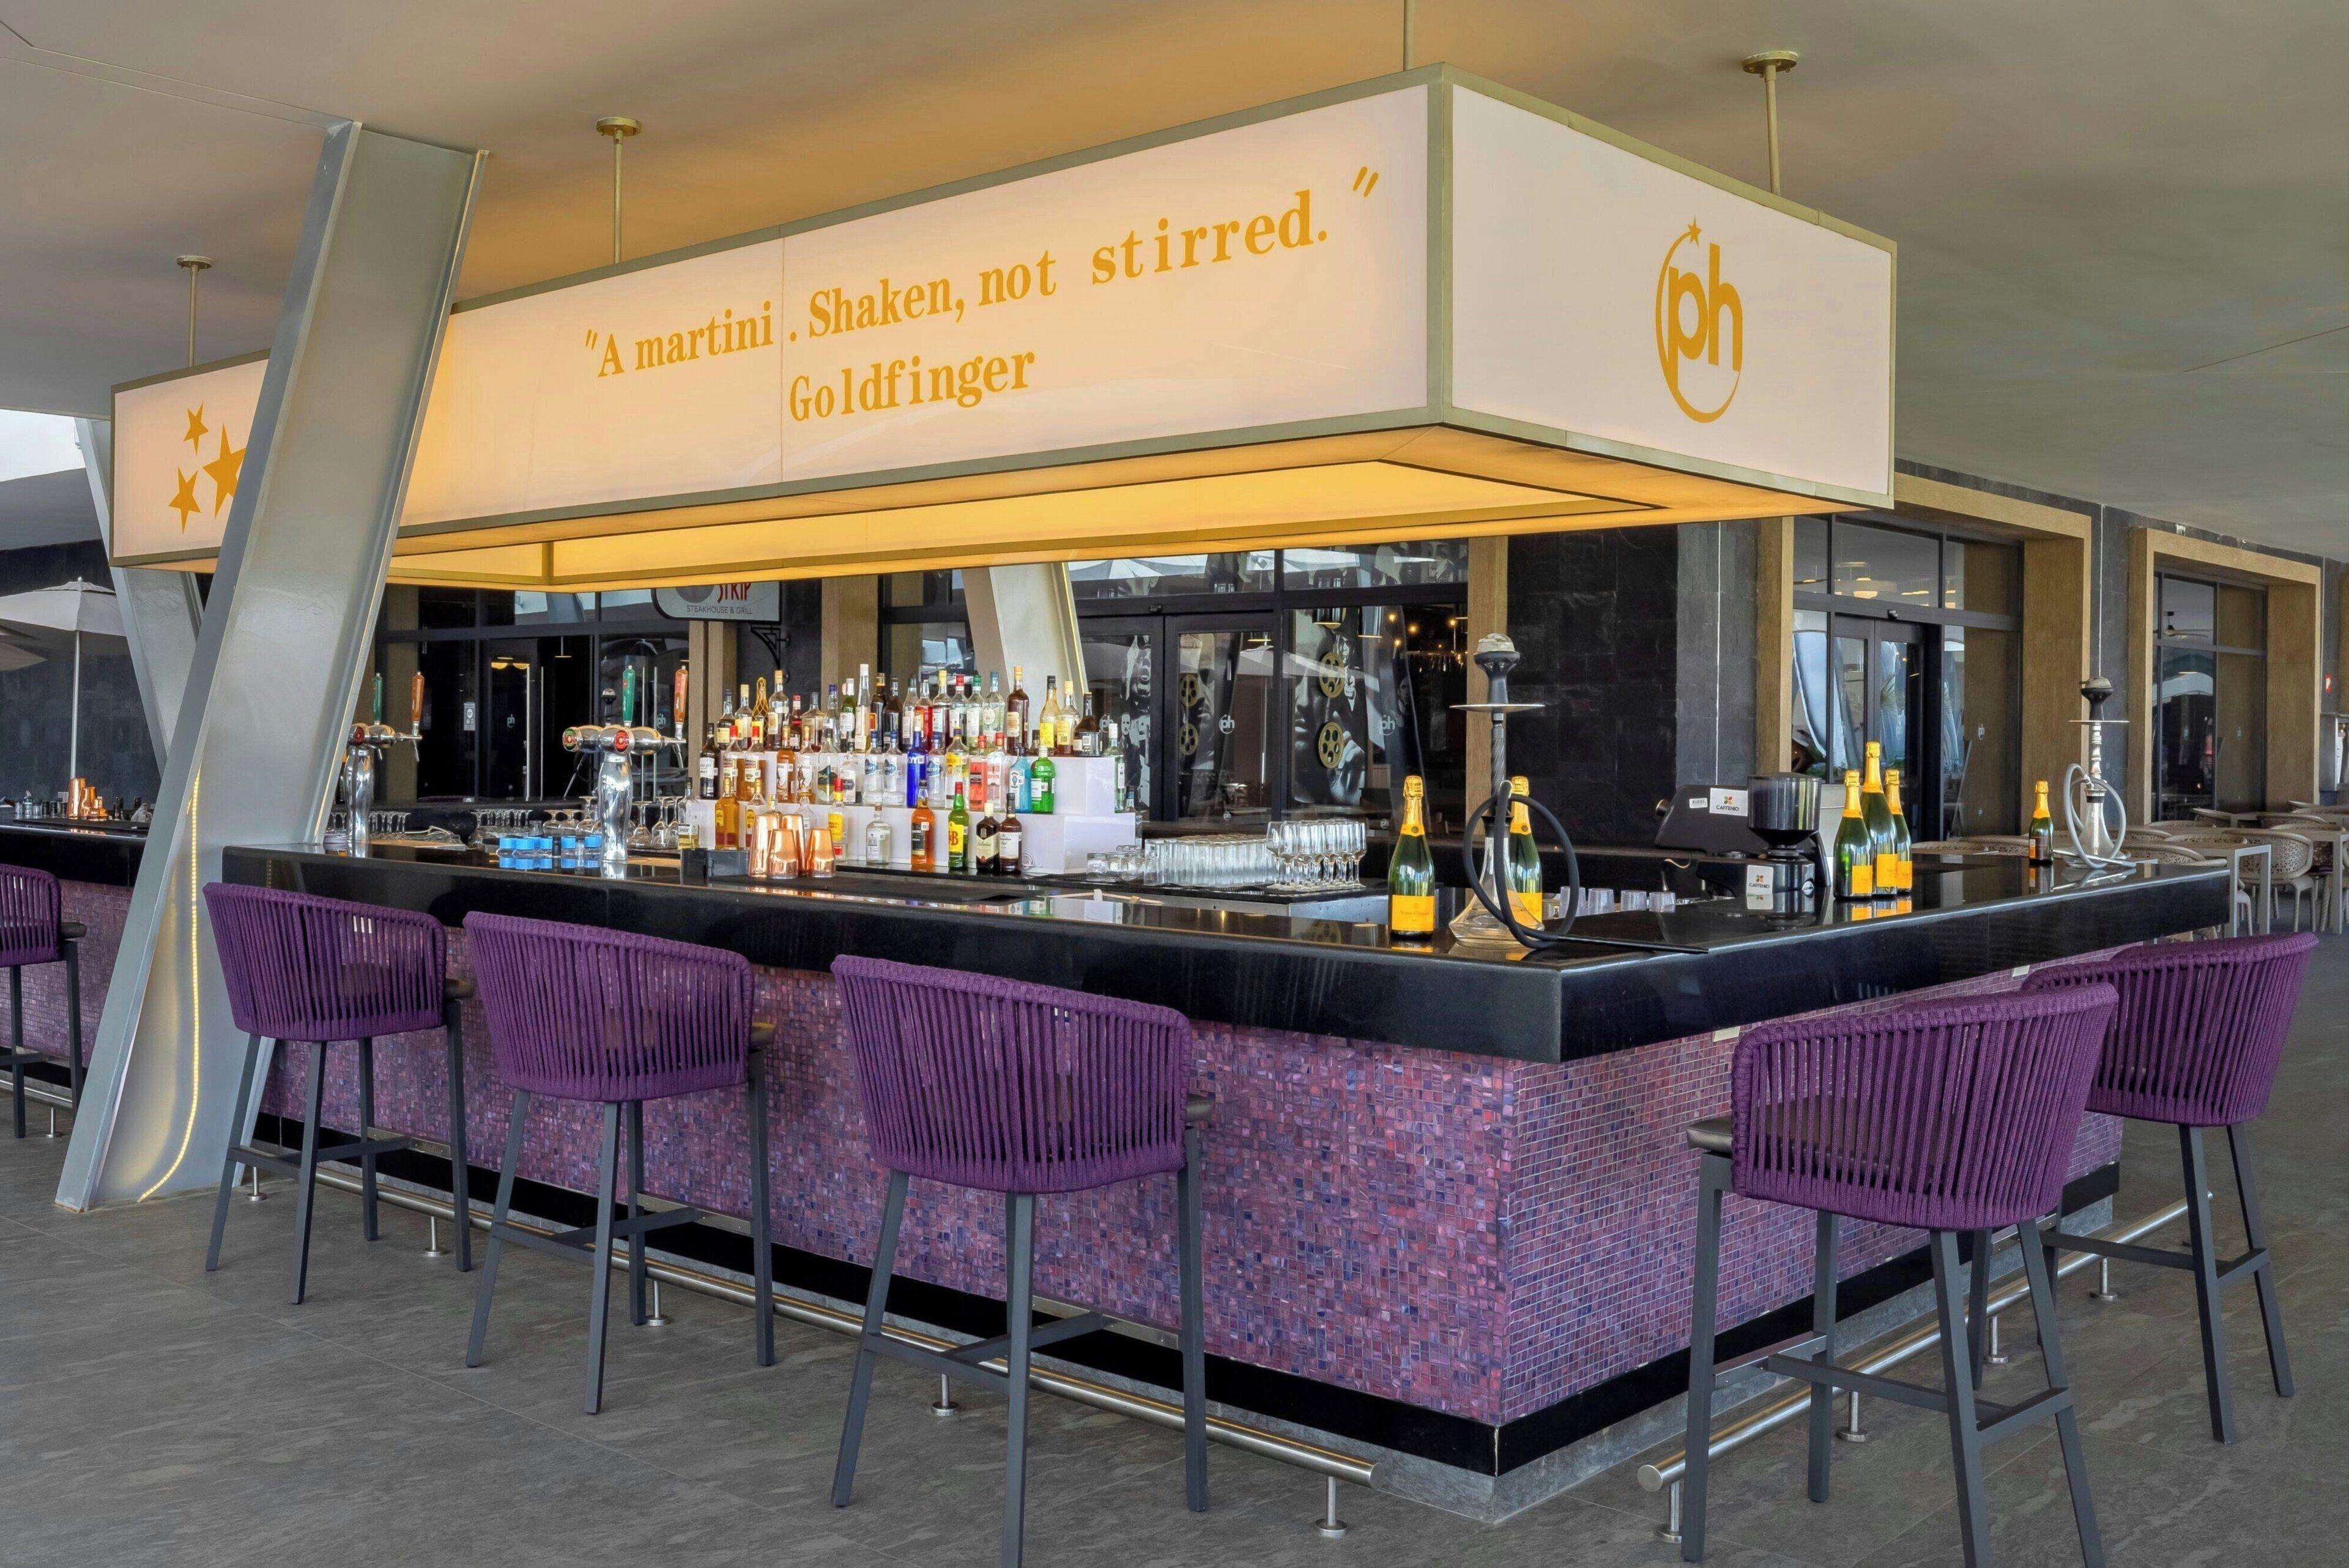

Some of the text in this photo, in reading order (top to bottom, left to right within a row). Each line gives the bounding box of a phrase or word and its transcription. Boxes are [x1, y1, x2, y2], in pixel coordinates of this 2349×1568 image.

[809, 278, 965, 338] Shaken,
[978, 250, 1056, 307] not
[789, 351, 1035, 422] Goldfinger
[686, 604, 729, 614] STEAKHOUSE
[735, 606, 753, 615] GRILL
